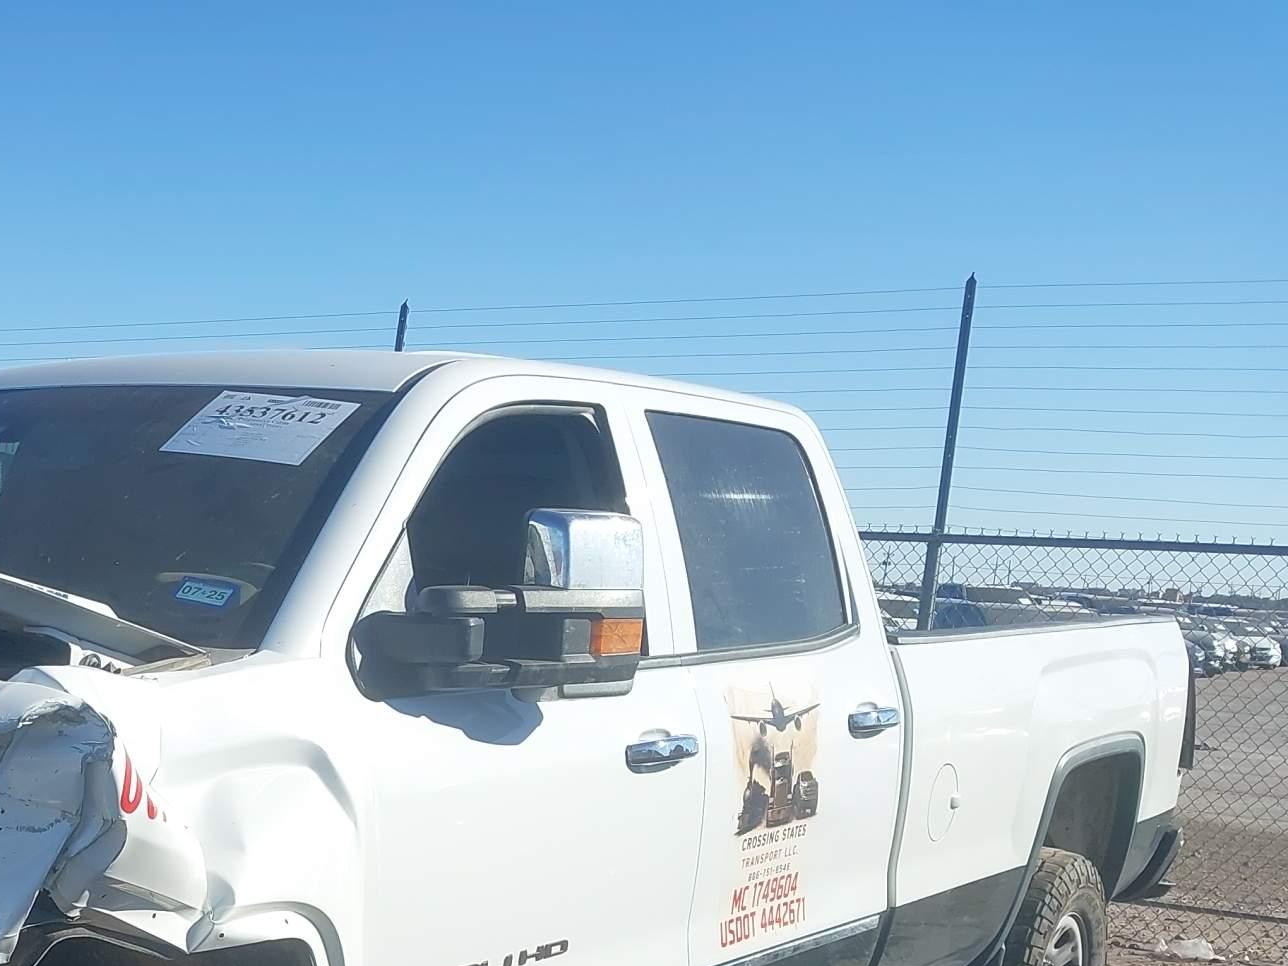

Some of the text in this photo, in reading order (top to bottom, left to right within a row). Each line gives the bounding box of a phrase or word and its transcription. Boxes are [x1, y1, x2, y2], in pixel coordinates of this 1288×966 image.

[215, 404, 327, 425] 43537612
[741, 824, 807, 852] CROSSING STATES
[741, 848, 783, 869] TRANSPORT
[731, 872, 799, 915] MC 1749604
[720, 897, 806, 948] USDOT 4442671
[518, 939, 569, 966] HD
